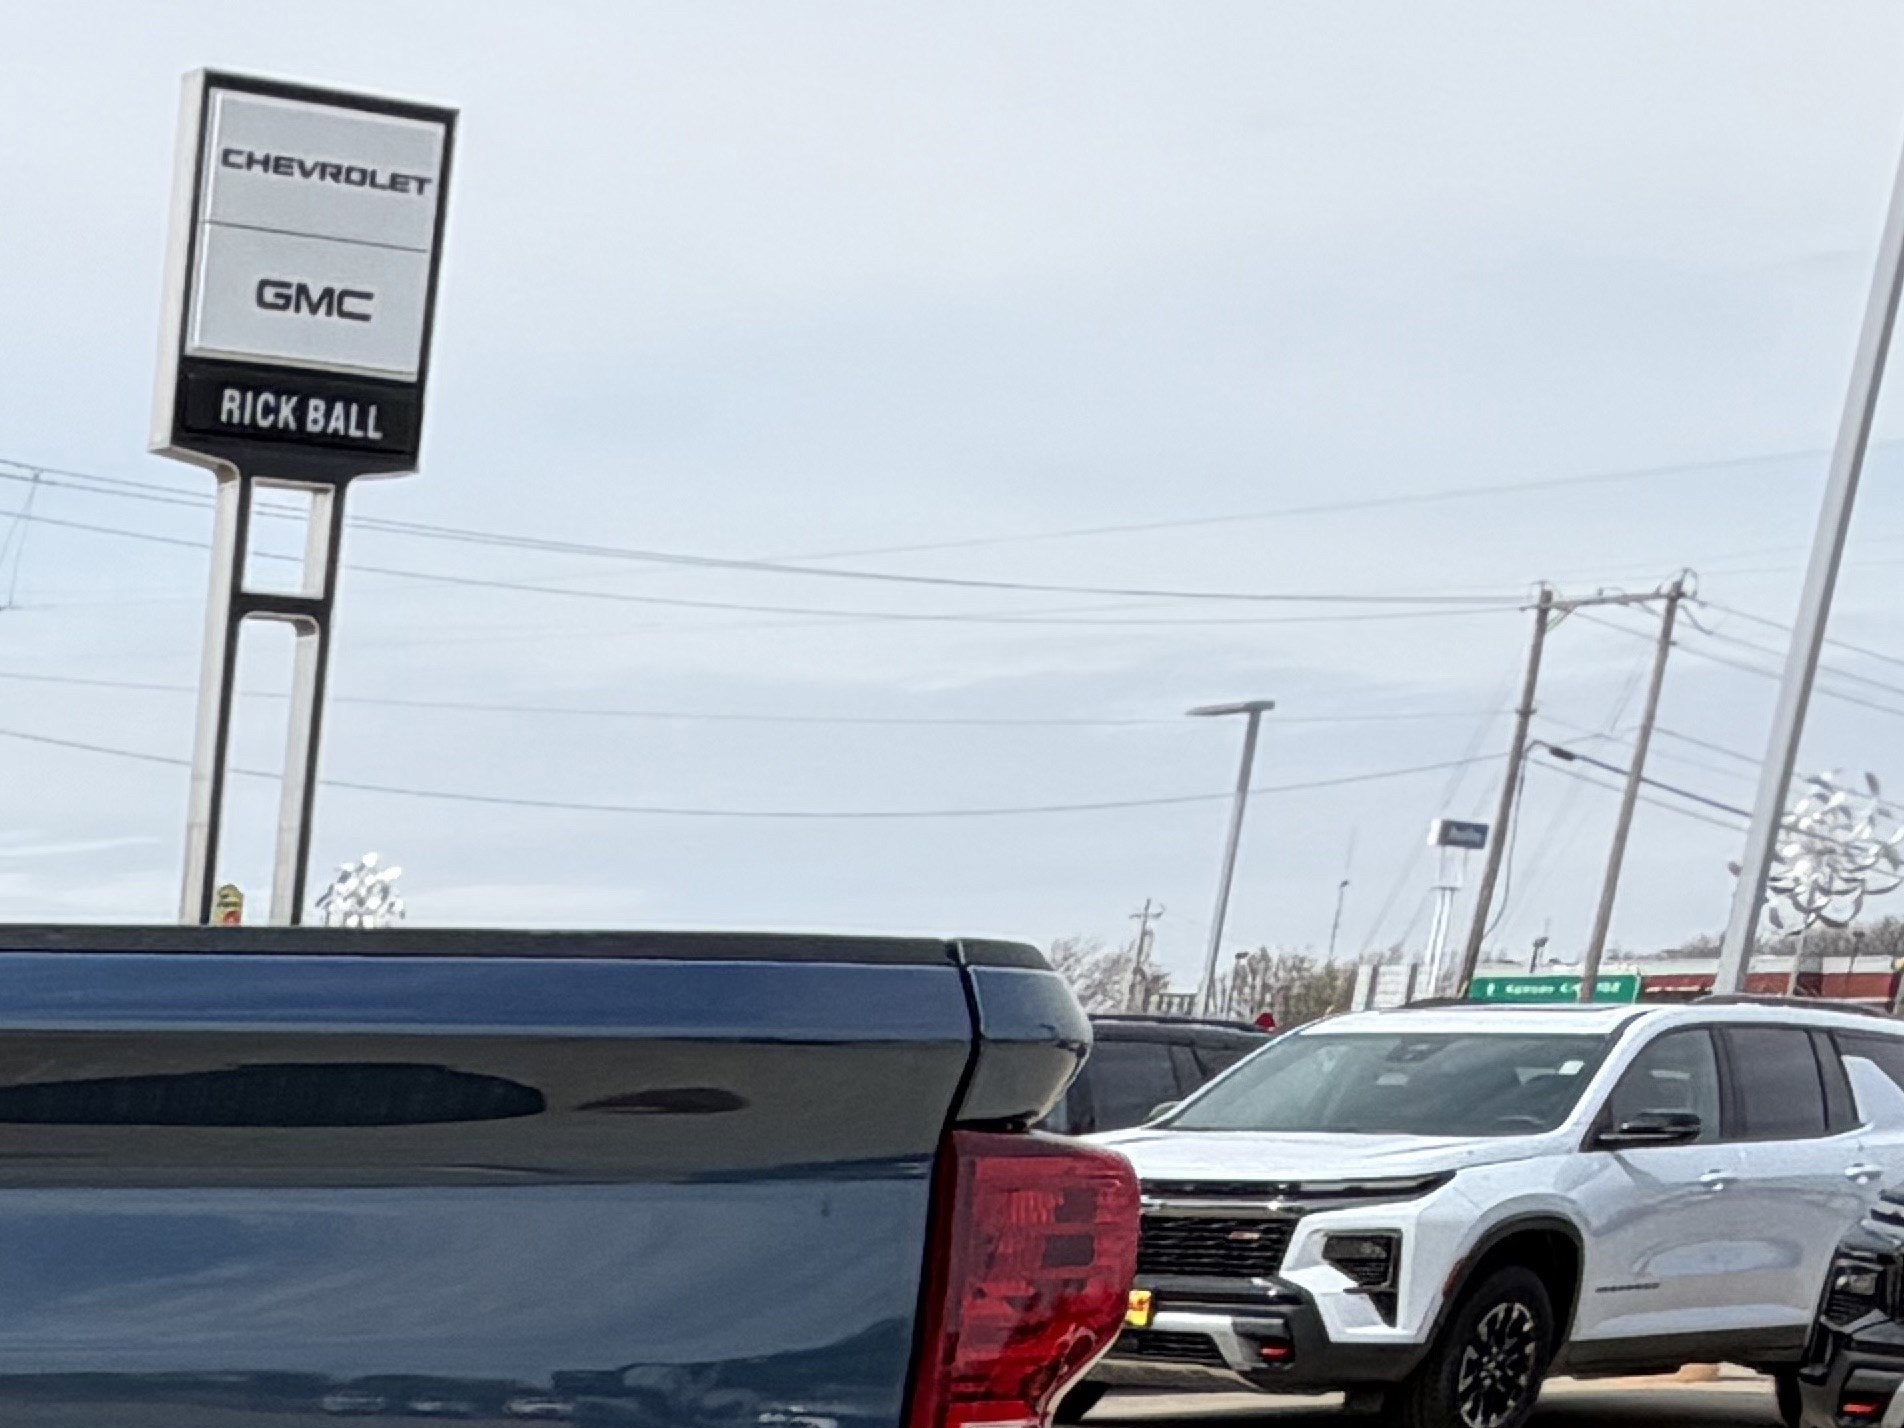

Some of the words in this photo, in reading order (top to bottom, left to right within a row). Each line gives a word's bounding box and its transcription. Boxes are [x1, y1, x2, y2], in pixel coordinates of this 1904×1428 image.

[221, 148, 432, 195] CHEVROLET
[256, 278, 374, 322] GMC
[220, 388, 297, 431] RICK
[307, 399, 383, 440] BALL
